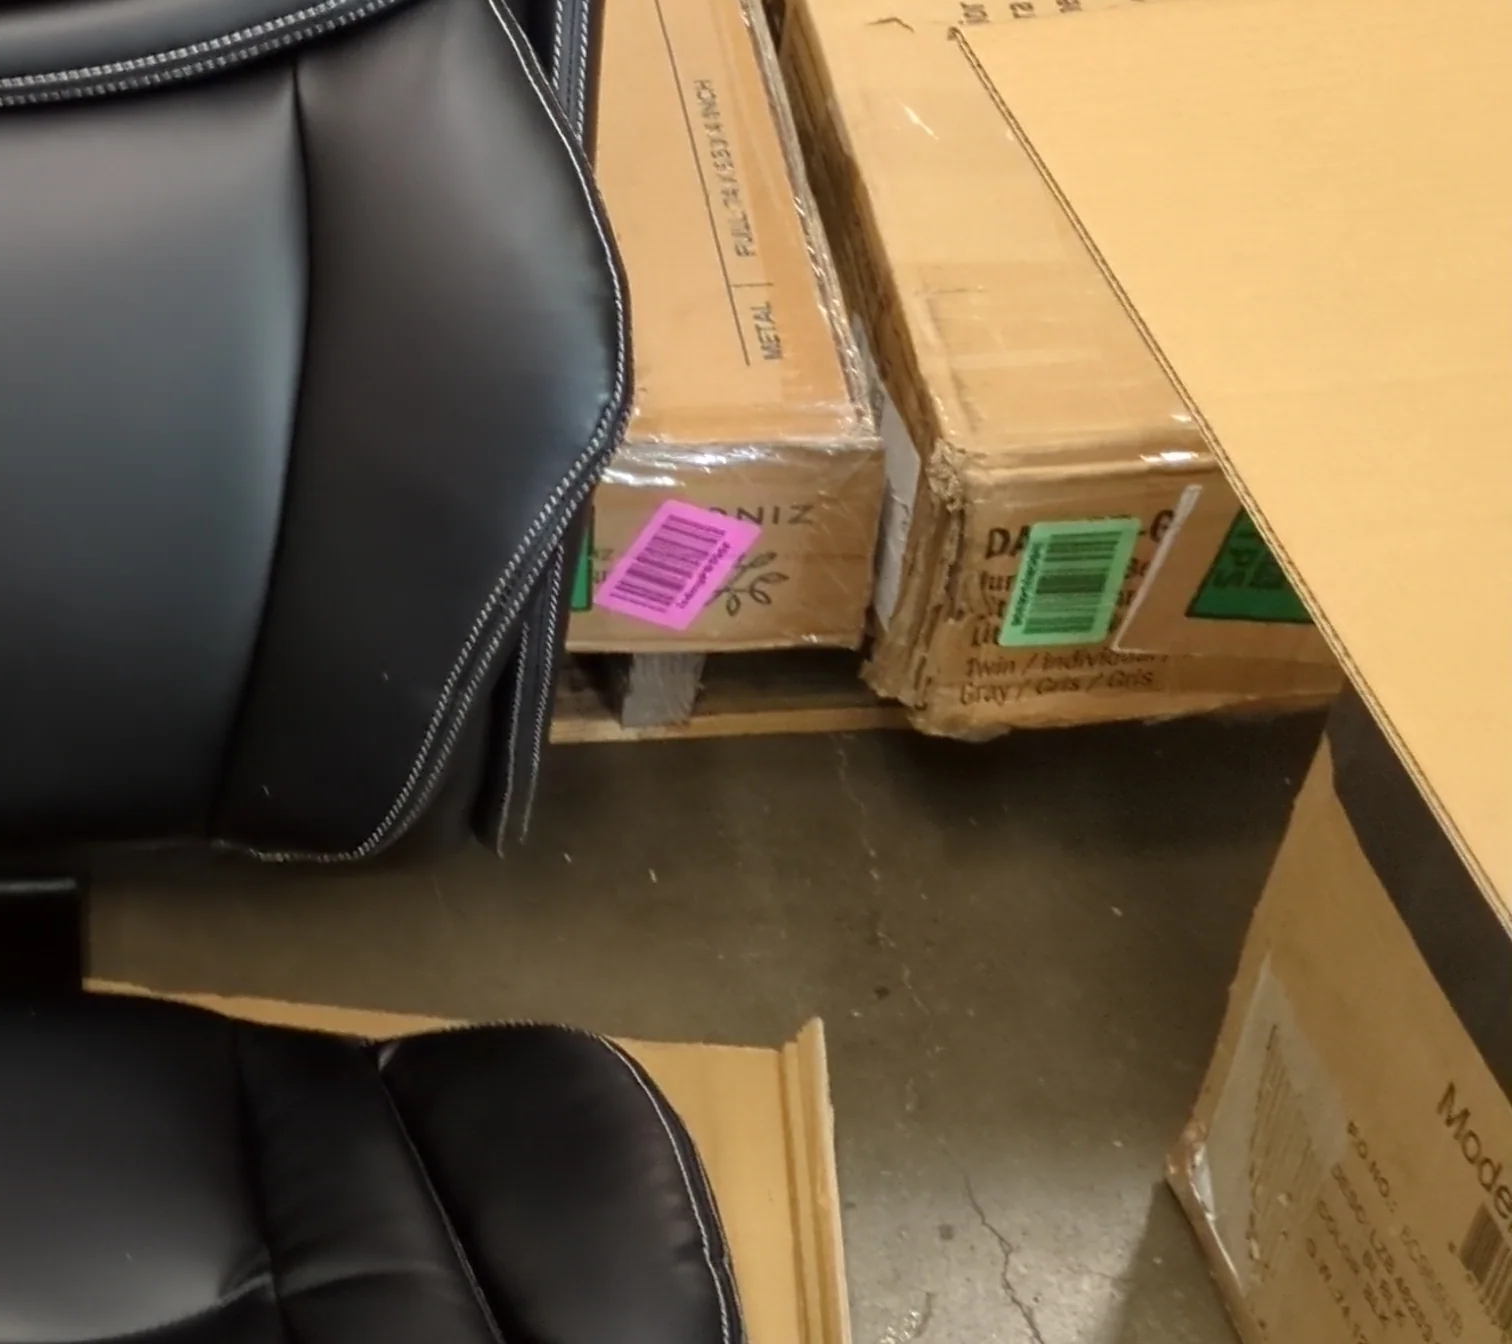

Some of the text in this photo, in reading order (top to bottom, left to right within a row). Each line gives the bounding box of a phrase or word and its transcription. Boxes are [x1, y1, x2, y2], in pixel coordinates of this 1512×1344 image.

[751, 301, 782, 360] METAL
[961, 682, 1007, 707] Gray
[1107, 668, 1154, 688] Gris
[1437, 1081, 1512, 1233] Mode
